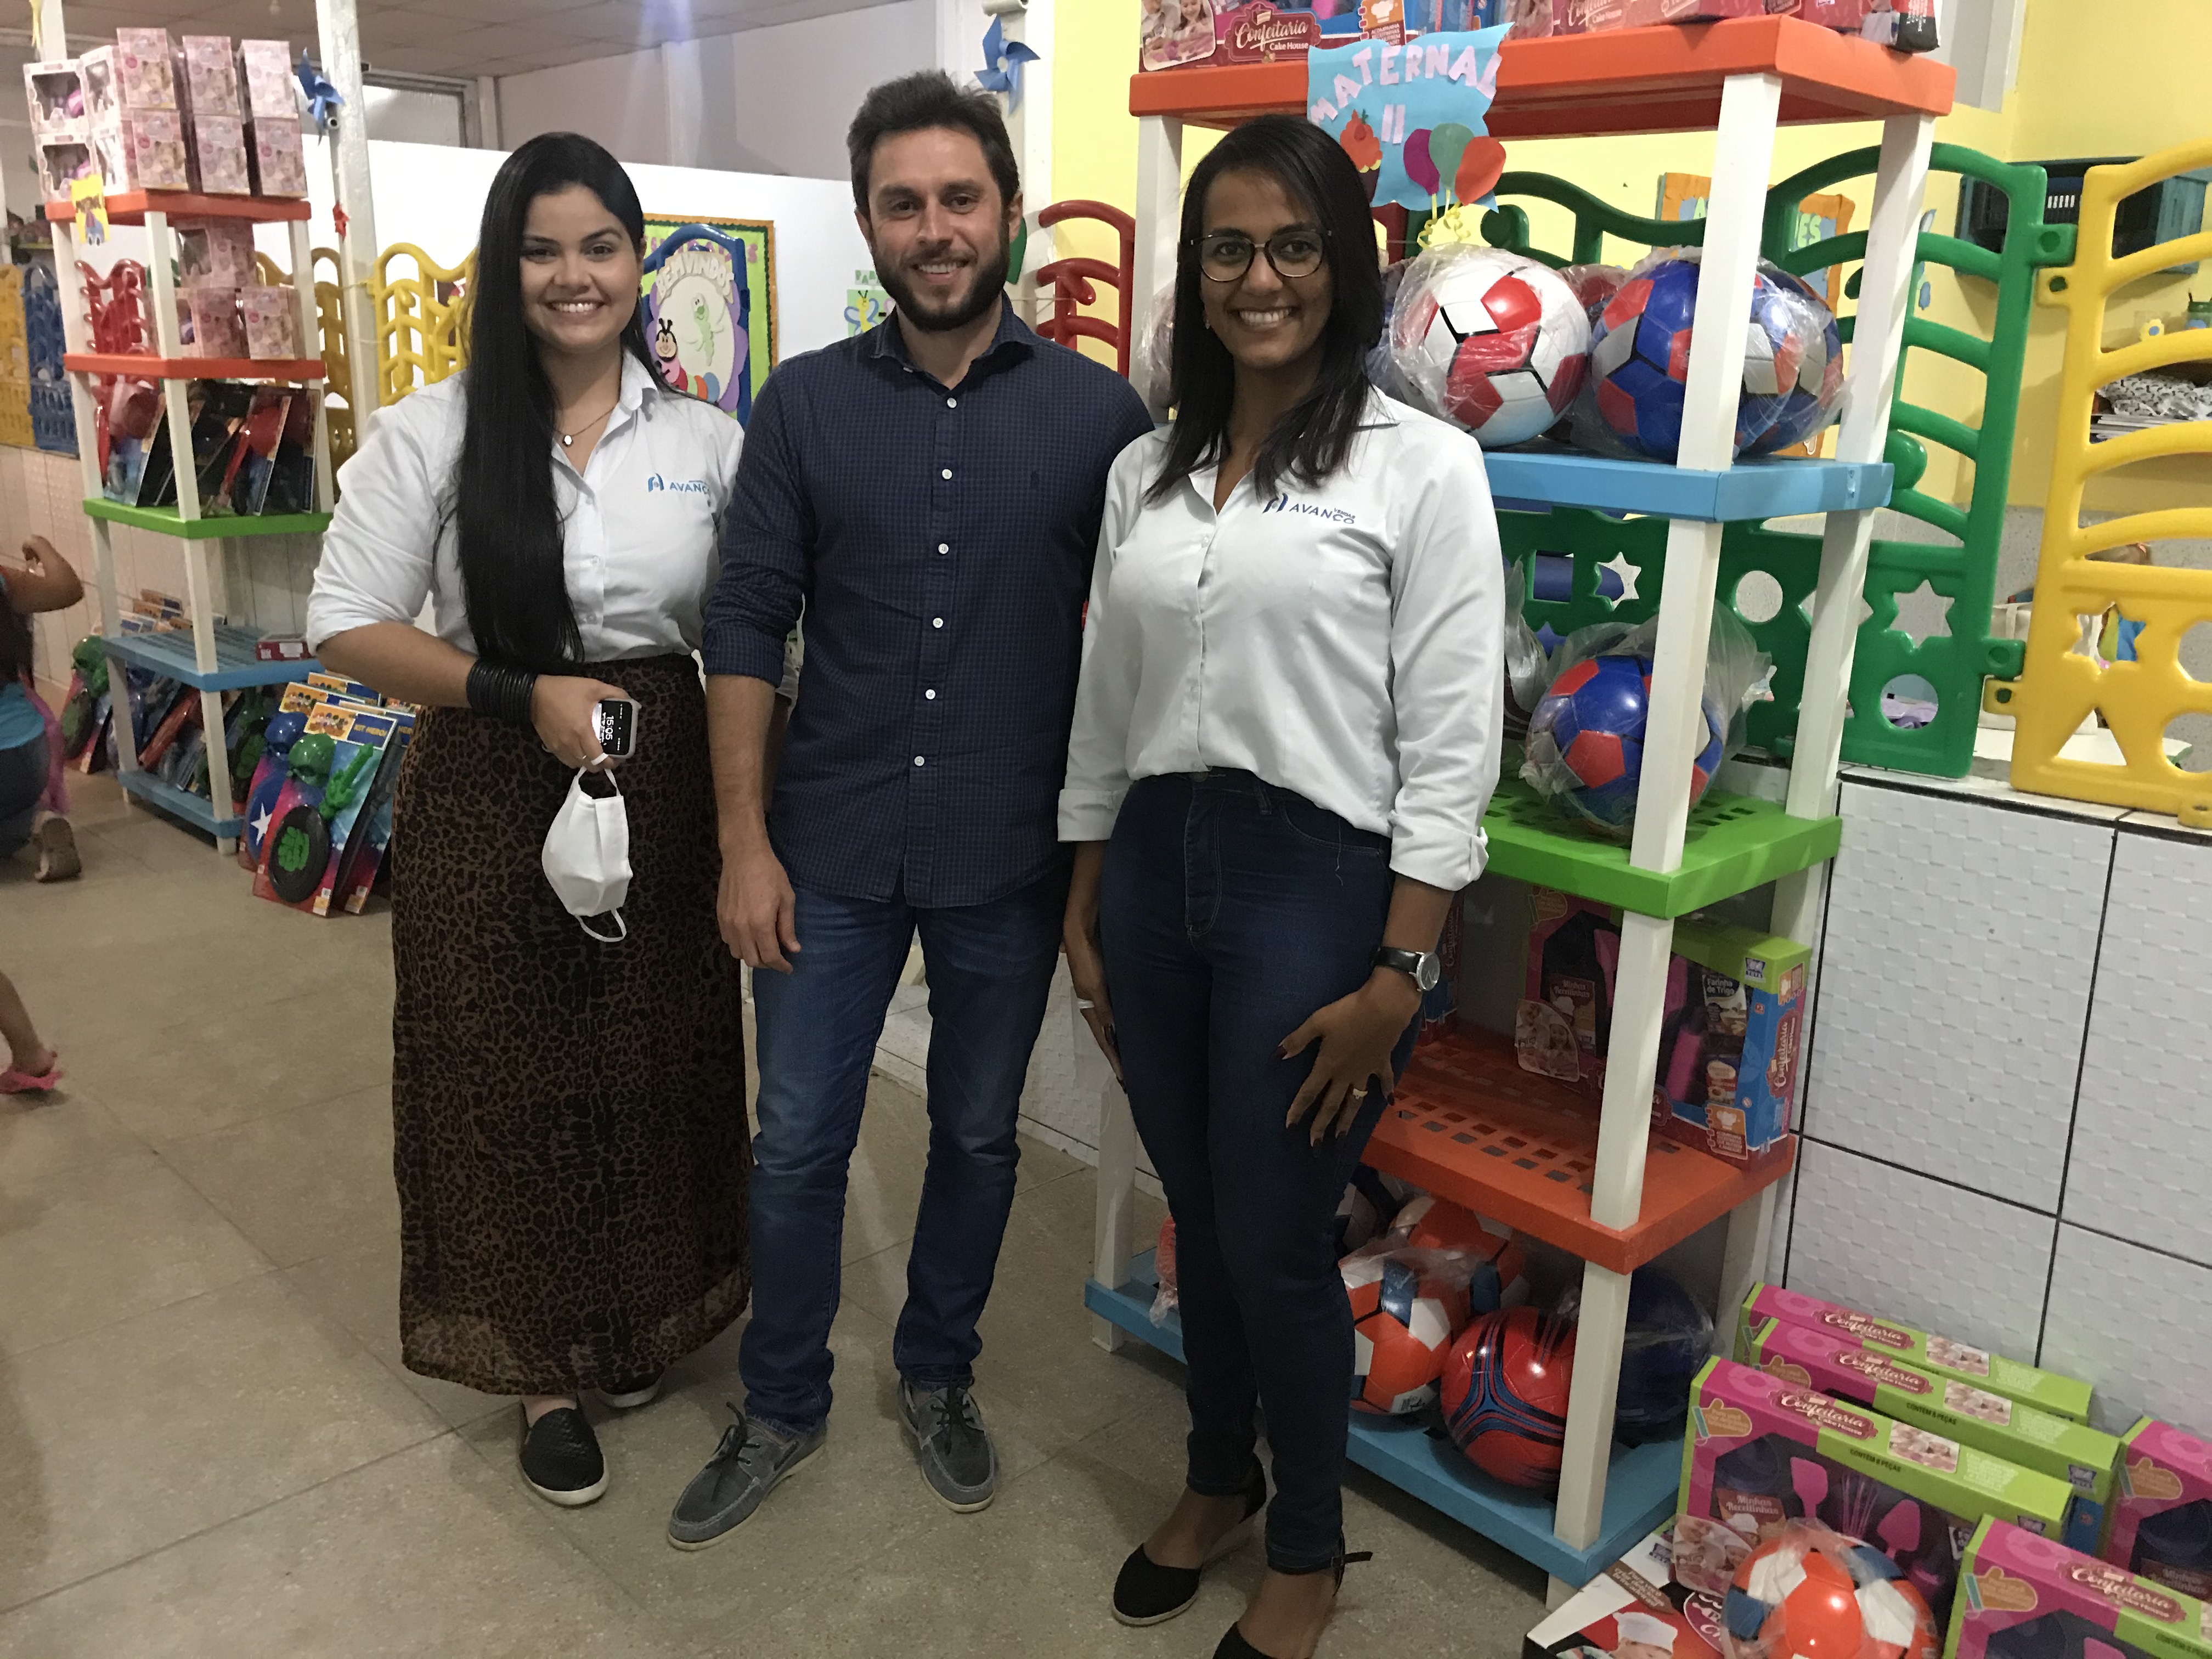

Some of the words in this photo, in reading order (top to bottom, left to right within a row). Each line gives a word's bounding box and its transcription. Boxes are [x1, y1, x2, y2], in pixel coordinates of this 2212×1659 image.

[1236, 20, 1308, 52] Confeitaria
[1310, 43, 1502, 125] MATERNAL
[605, 715, 614, 740] 15:05
[1707, 978, 1733, 987] Farinha
[1716, 987, 1735, 996] Trigo
[1774, 1022, 1791, 1088] Confeitaria
[1839, 1353, 1919, 1384] Confeitaria
[1781, 1393, 1865, 1428] Confeitaria
[1726, 1502, 1779, 1514] Receitinhas
[1736, 1495, 1772, 1506] Minhas
[2072, 1566, 2172, 1608] Confeitaria
